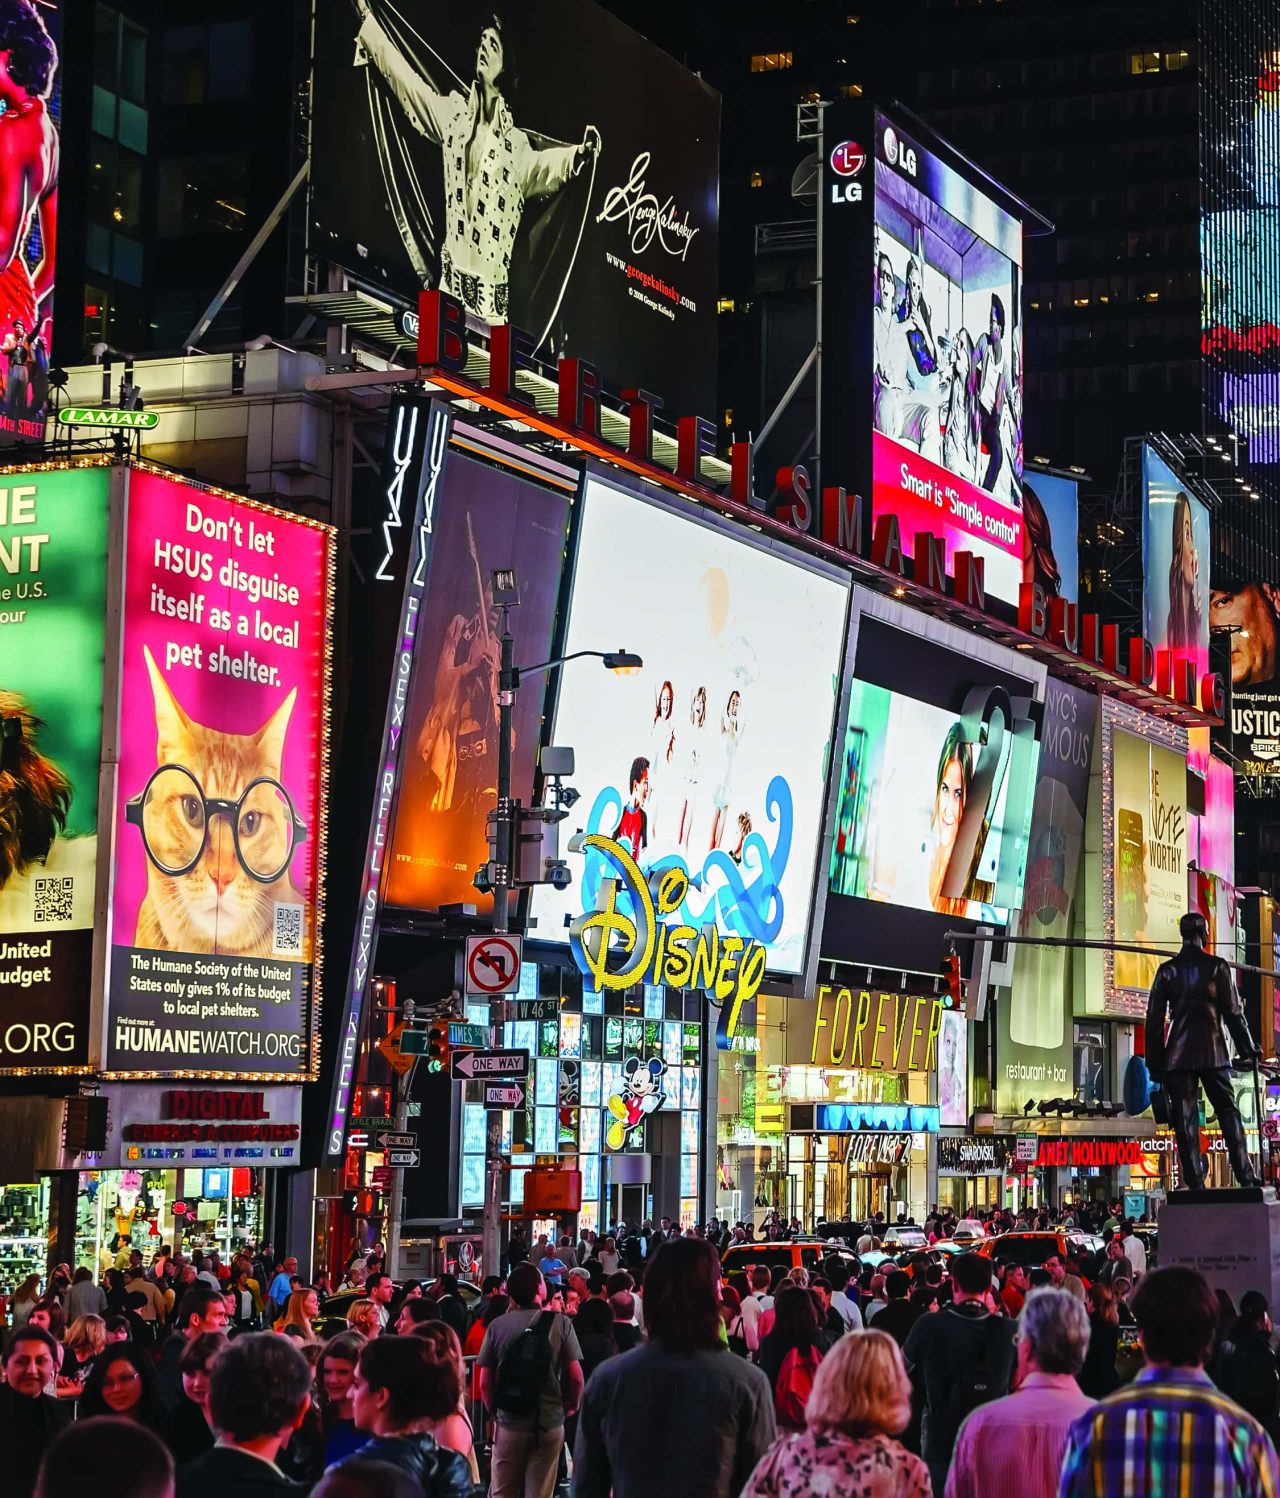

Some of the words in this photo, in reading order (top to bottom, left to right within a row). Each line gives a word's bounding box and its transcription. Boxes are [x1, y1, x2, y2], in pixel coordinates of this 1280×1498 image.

[898, 142, 917, 178] LG
[832, 182, 863, 203] LG
[606, 252, 697, 312] www.georgekalinsky.com
[18, 419, 45, 439] STREET
[67, 409, 150, 427] LAMAR
[900, 463, 933, 502] Smart
[934, 482, 943, 508] is
[418, 290, 985, 611] BERTELSMANN
[1019, 581, 1225, 718] BUILDING
[186, 503, 243, 547] Don't
[248, 521, 275, 557] let
[154, 538, 213, 582] HSUS
[219, 557, 300, 607] disguise
[16, 581, 48, 599] U.S.
[150, 582, 205, 624] itself
[208, 606, 232, 632] as
[236, 614, 249, 637] a
[254, 609, 299, 649] local
[165, 641, 203, 671] pet
[208, 644, 281, 688] shelter.
[390, 653, 411, 751] SEXY
[1046, 686, 1078, 723] NYC's
[1231, 692, 1255, 701] hunting
[1254, 694, 1267, 702] just
[1151, 798, 1185, 845] NOTE
[1149, 839, 1182, 875] WORTHY
[354, 889, 378, 989] SEXY
[130, 954, 150, 970] The
[152, 957, 193, 974] Humane
[194, 960, 230, 980] Society
[231, 965, 243, 977] of
[243, 967, 260, 979] the
[261, 966, 292, 982] United
[130, 975, 162, 993] States
[164, 979, 186, 998] only
[187, 982, 213, 999] gives
[215, 982, 231, 996] 1%
[232, 983, 244, 997] of
[244, 983, 256, 998] its
[257, 987, 291, 1004] budget
[117, 1016, 128, 1025] Find
[127, 1018, 138, 1026] out
[163, 1000, 175, 1014] to
[177, 1000, 200, 1016] local
[201, 1003, 219, 1019] pet
[220, 1002, 260, 1018] shelters.
[519, 1003, 529, 1014] W
[531, 1002, 544, 1018] 46
[547, 1001, 557, 1010] ST
[115, 1025, 301, 1057] HUMANEWATCH.ORG
[449, 1025, 473, 1044] TIMES
[811, 985, 943, 1071] FOREVER
[472, 1059, 493, 1071] ONE
[499, 1057, 521, 1070] WAY
[1006, 1062, 1045, 1082] restaurant
[1052, 1066, 1067, 1083] bar
[330, 1011, 360, 1153] REELS
[490, 1090, 502, 1101] ONE
[507, 1089, 521, 1101] WAY
[163, 1090, 270, 1120] DIGITAL
[126, 1124, 200, 1143] CAMERAS
[220, 1123, 300, 1143] COMPUTERS
[349, 1117, 369, 1126] LITTLE
[371, 1117, 395, 1126] BRAZIL
[386, 1137, 398, 1145] ONE
[845, 1134, 900, 1163] FOREVER
[960, 1145, 995, 1162] SWAROVSKI
[1072, 1141, 1141, 1165] HOLLYWOOD
